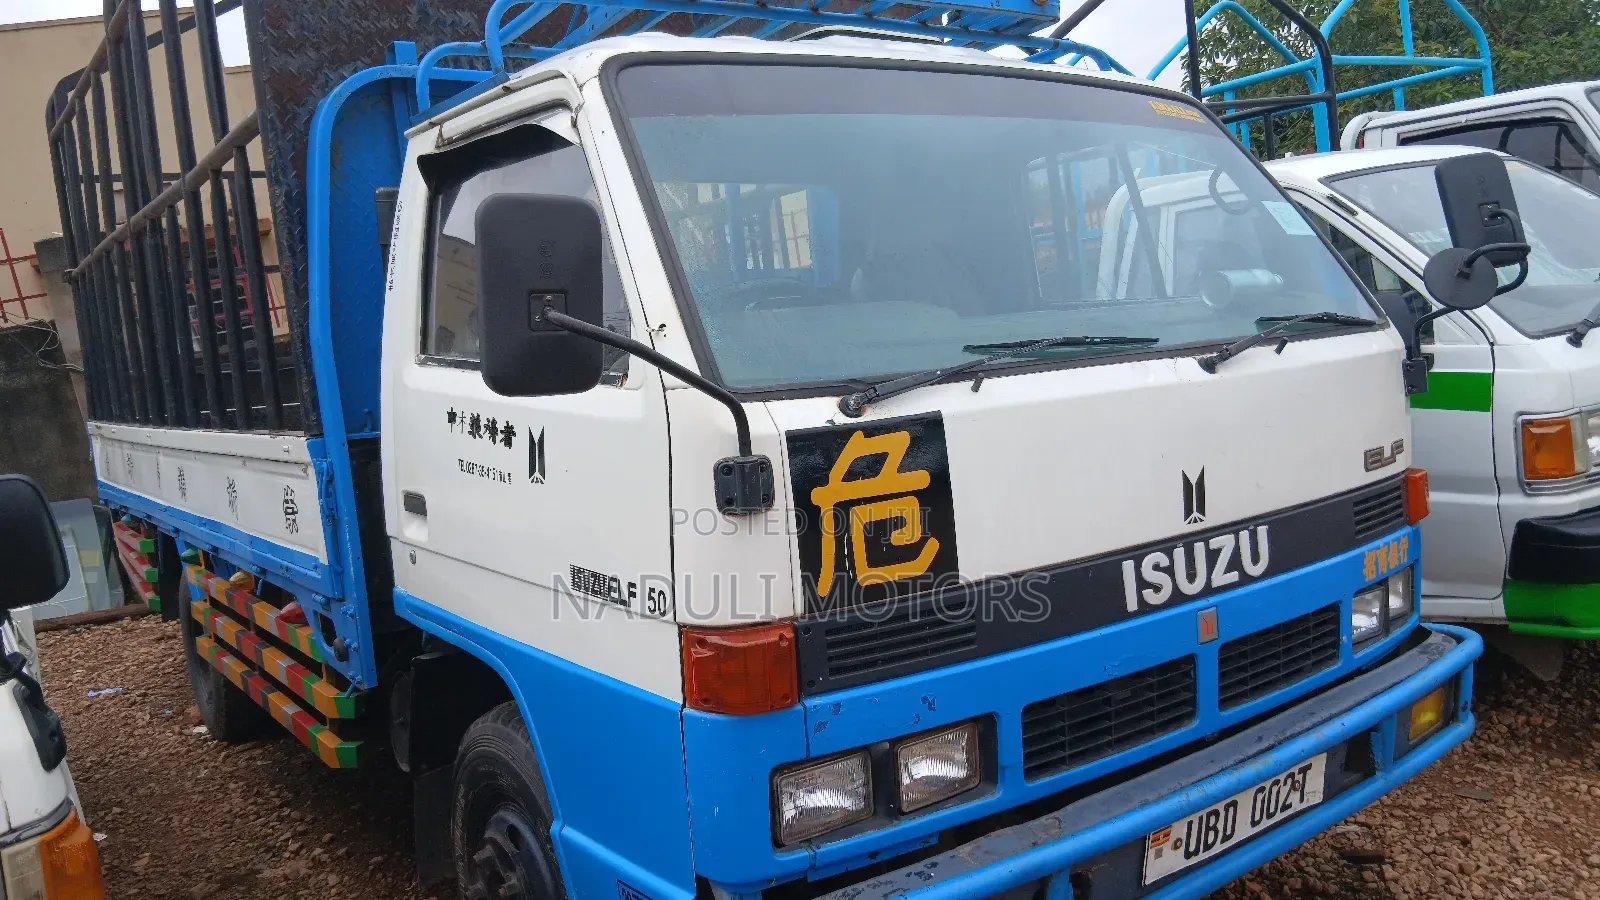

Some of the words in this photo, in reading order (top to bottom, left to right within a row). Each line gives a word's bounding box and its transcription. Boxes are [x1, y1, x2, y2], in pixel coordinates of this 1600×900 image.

[1363, 438, 1405, 473] ELF
[810, 429, 940, 598] 危
[1121, 524, 1270, 613] ISUZU
[1183, 799, 1239, 860] UBD
[1250, 762, 1313, 828] 002T
